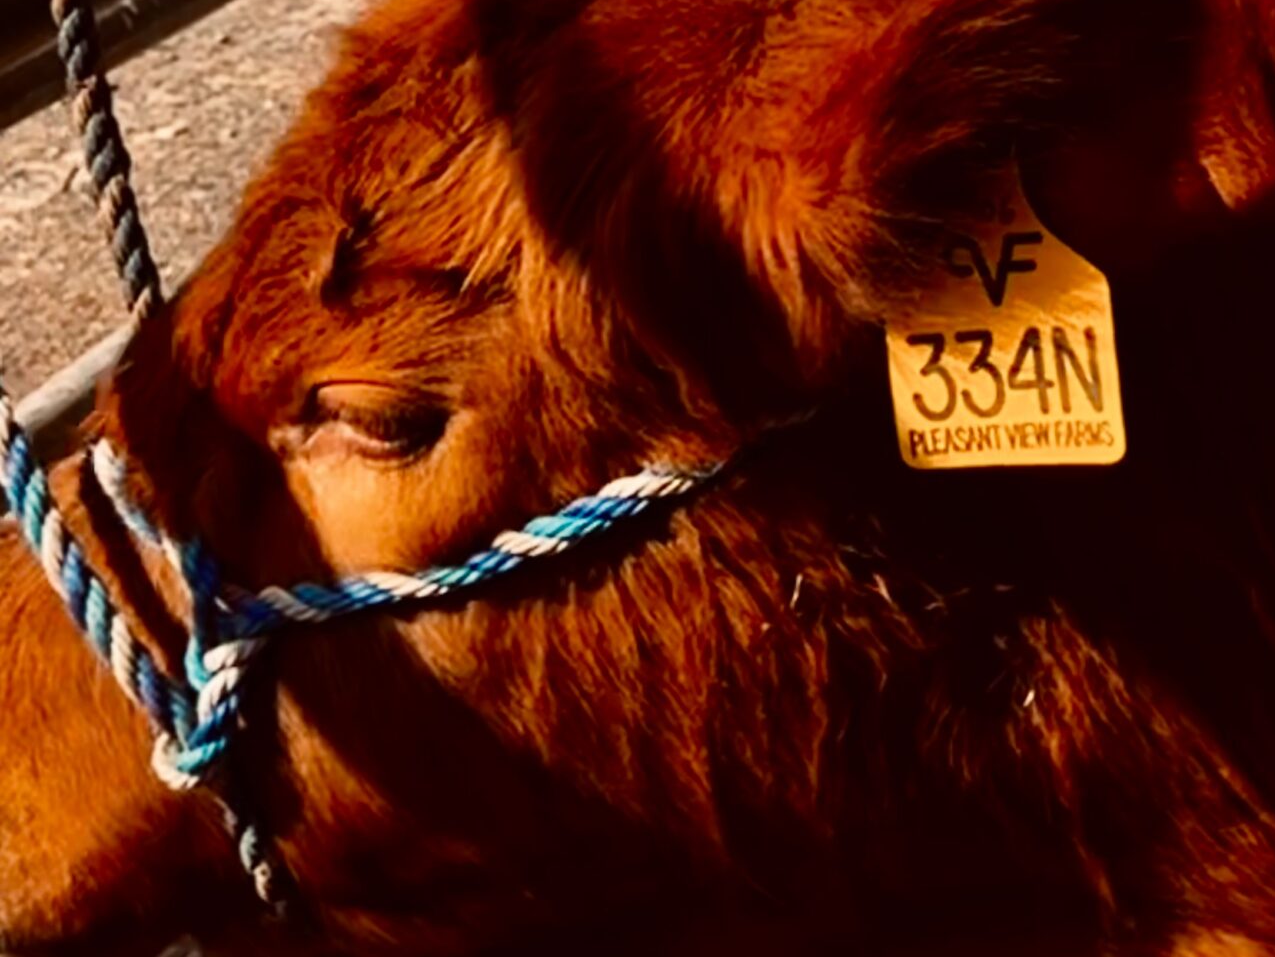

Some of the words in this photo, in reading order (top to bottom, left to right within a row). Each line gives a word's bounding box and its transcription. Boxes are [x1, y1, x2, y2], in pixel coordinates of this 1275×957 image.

[906, 326, 1103, 422] 334N
[907, 424, 1002, 459] PLEASANT
[1004, 421, 1050, 450] VIEW
[1054, 419, 1115, 448] FARMS
